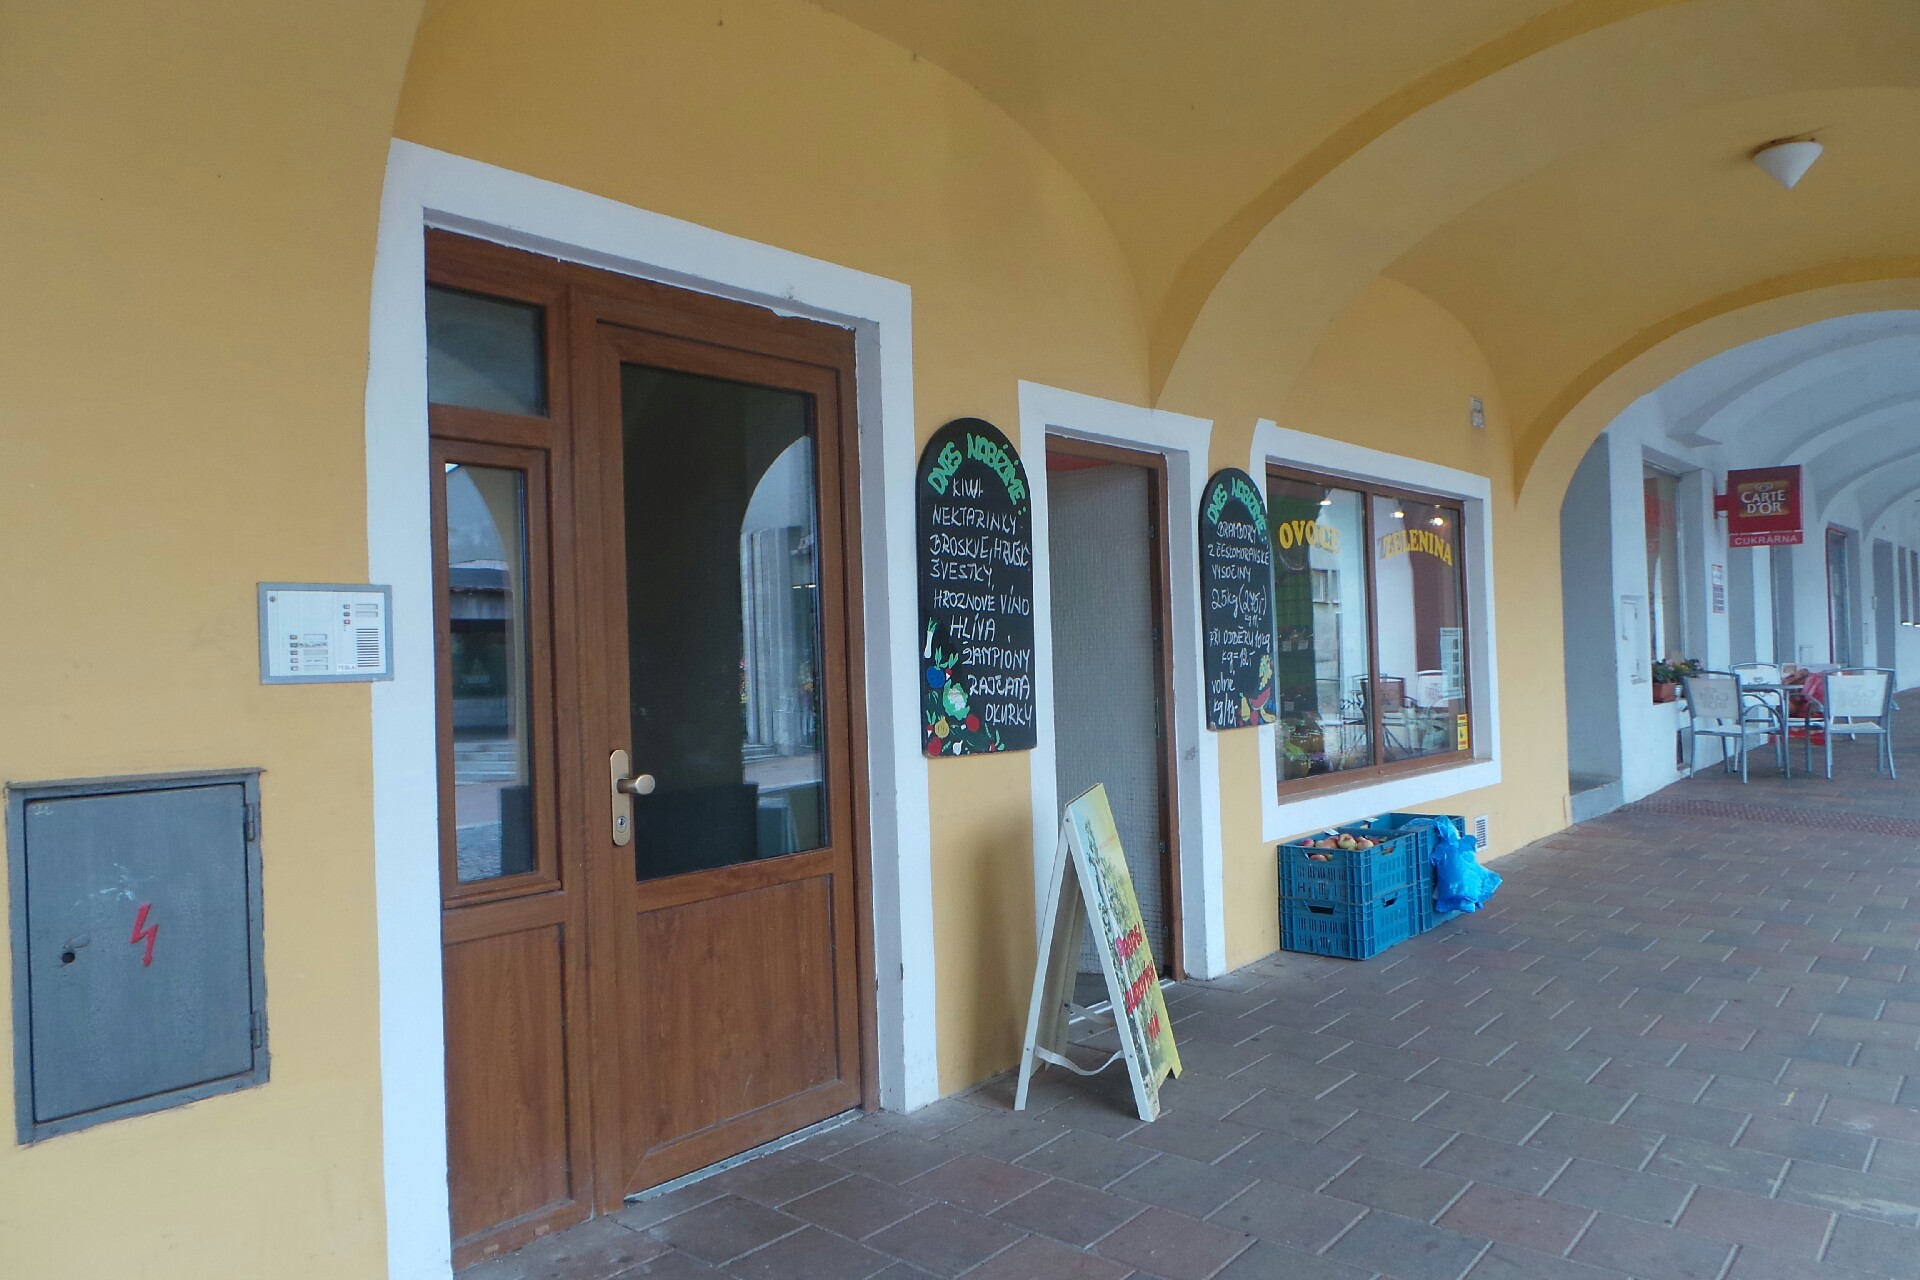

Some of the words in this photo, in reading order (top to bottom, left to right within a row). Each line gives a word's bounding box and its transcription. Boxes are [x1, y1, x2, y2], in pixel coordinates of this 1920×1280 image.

[928, 441, 962, 494] DNES
[1207, 483, 1227, 525] DNES
[1741, 489, 1786, 503] CARTE
[1747, 502, 1782, 514] D'OR
[932, 504, 1017, 535] NEKTARINKY
[1216, 521, 1257, 545] BRAMBORY
[1279, 520, 1341, 554] OVOCE
[1382, 528, 1453, 566] ZELENINA
[1211, 564, 1252, 583] VYSOČINY
[933, 583, 996, 612] HROZNOVÉ
[1000, 584, 1030, 616] VÍNO
[949, 612, 996, 642] HLÍVA
[1209, 627, 1221, 647] PŘI
[1223, 625, 1254, 648] ODBĚRU
[967, 674, 1031, 701] RAJČATA
[985, 702, 1033, 729] OKURKY
